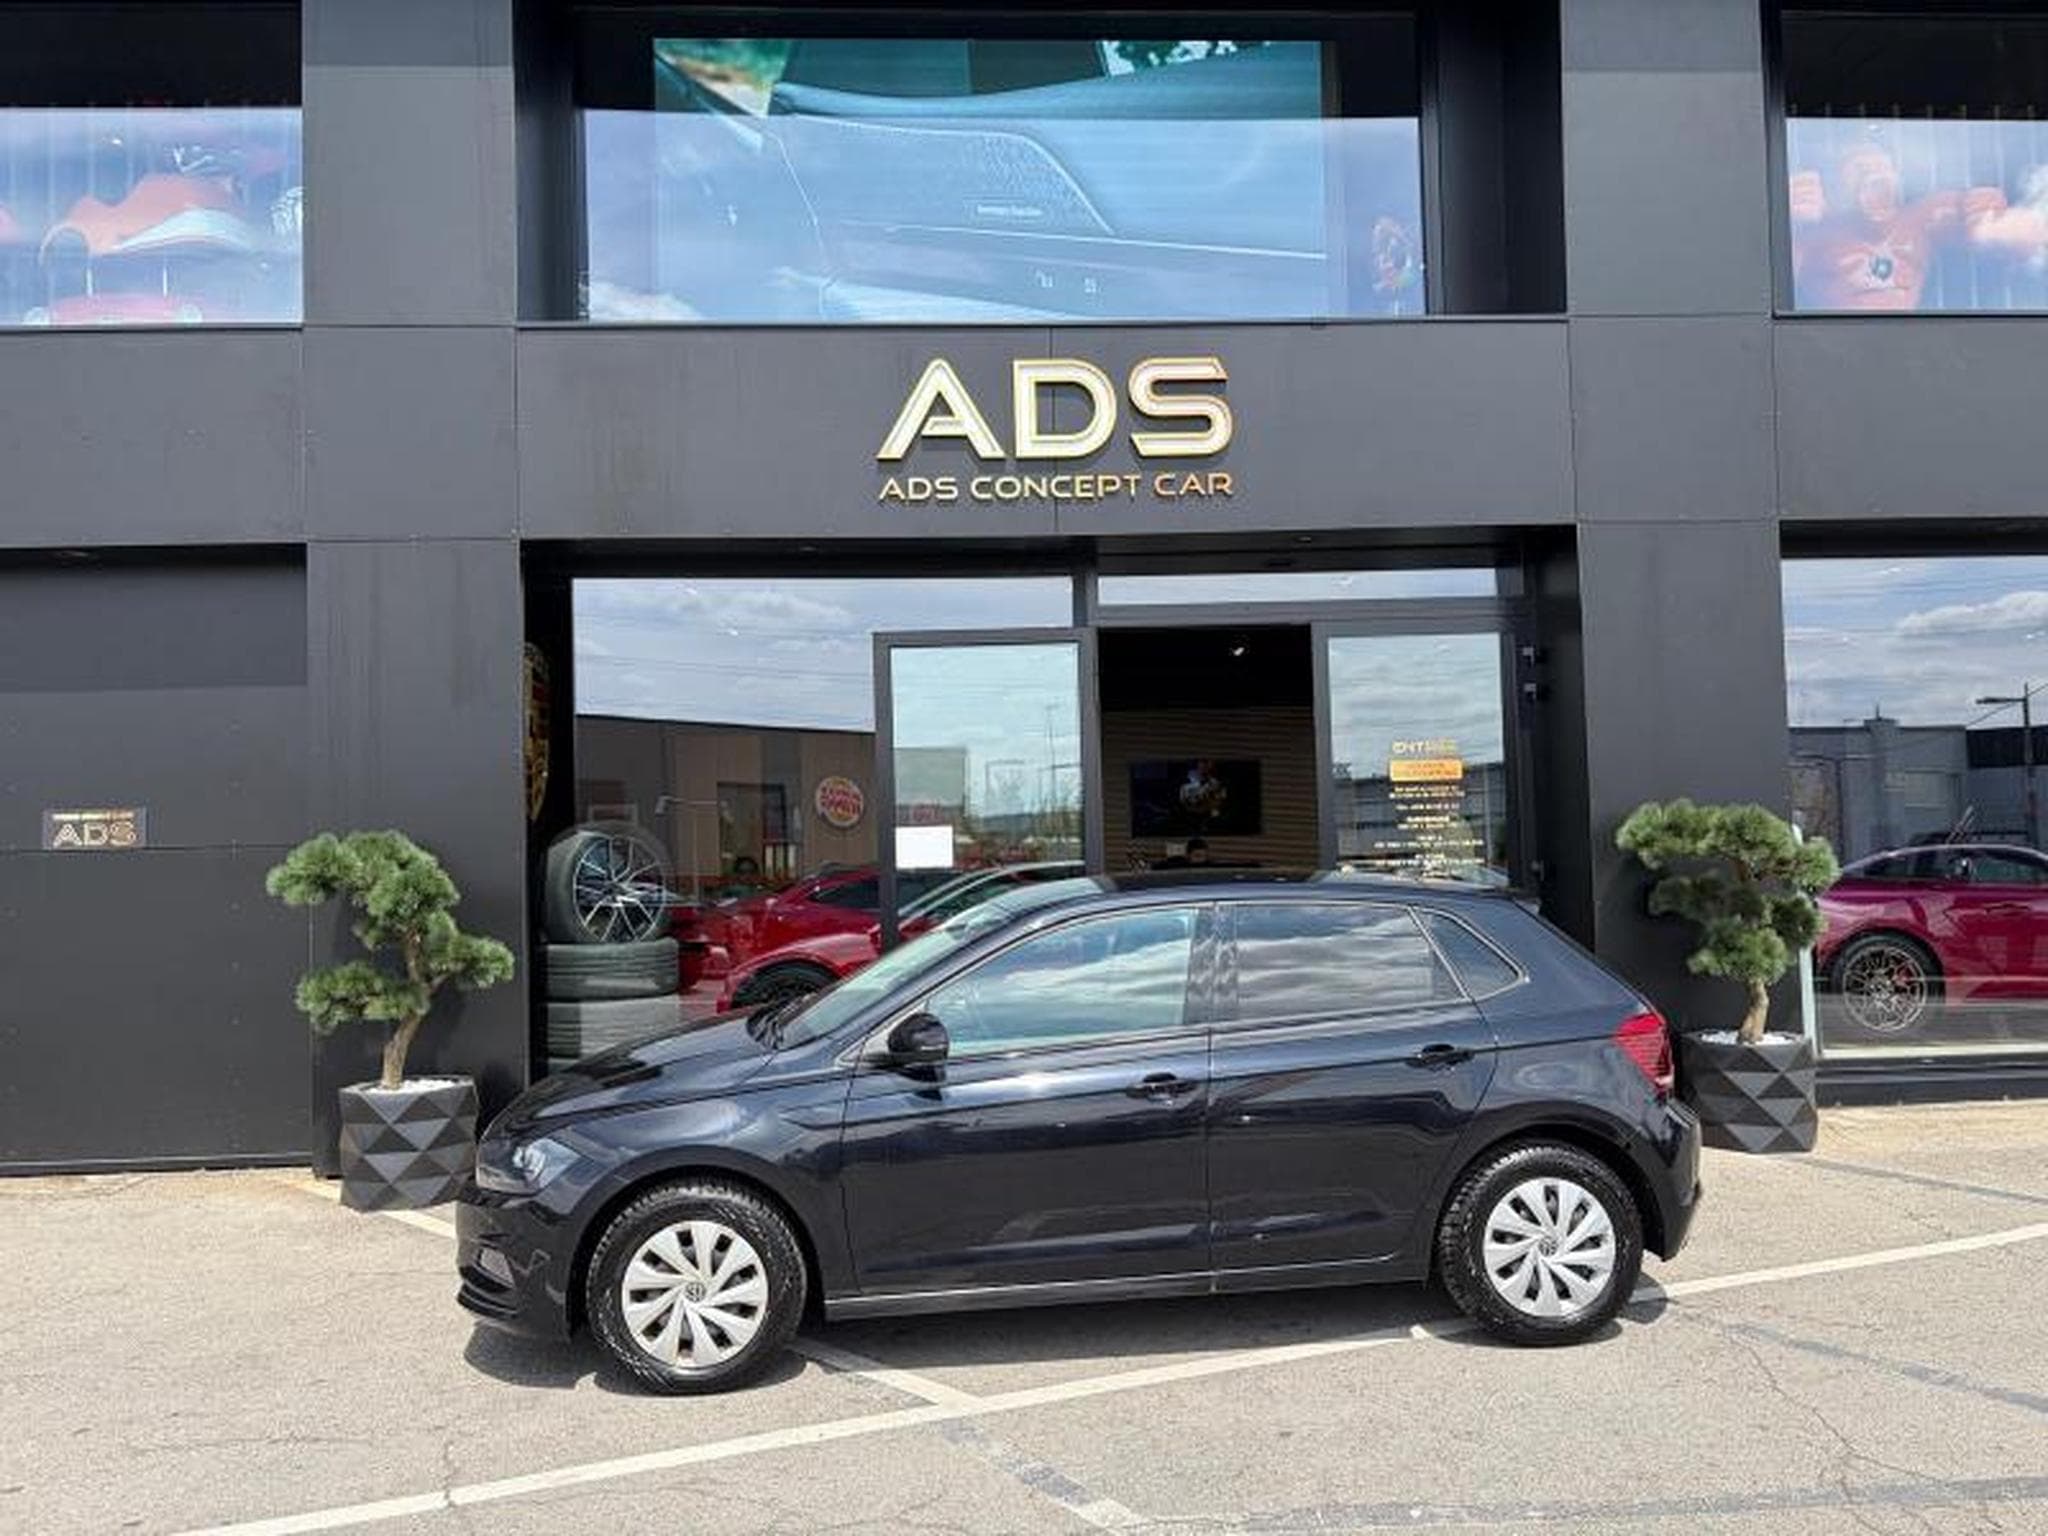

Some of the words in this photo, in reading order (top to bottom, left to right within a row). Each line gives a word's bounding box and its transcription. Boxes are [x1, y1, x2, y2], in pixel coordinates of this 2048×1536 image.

[876, 357, 1232, 460] ADS
[878, 476, 959, 502] ADS
[970, 474, 1142, 500] CONCEPT
[1153, 472, 1234, 498] CAR
[52, 822, 137, 847] ADS
